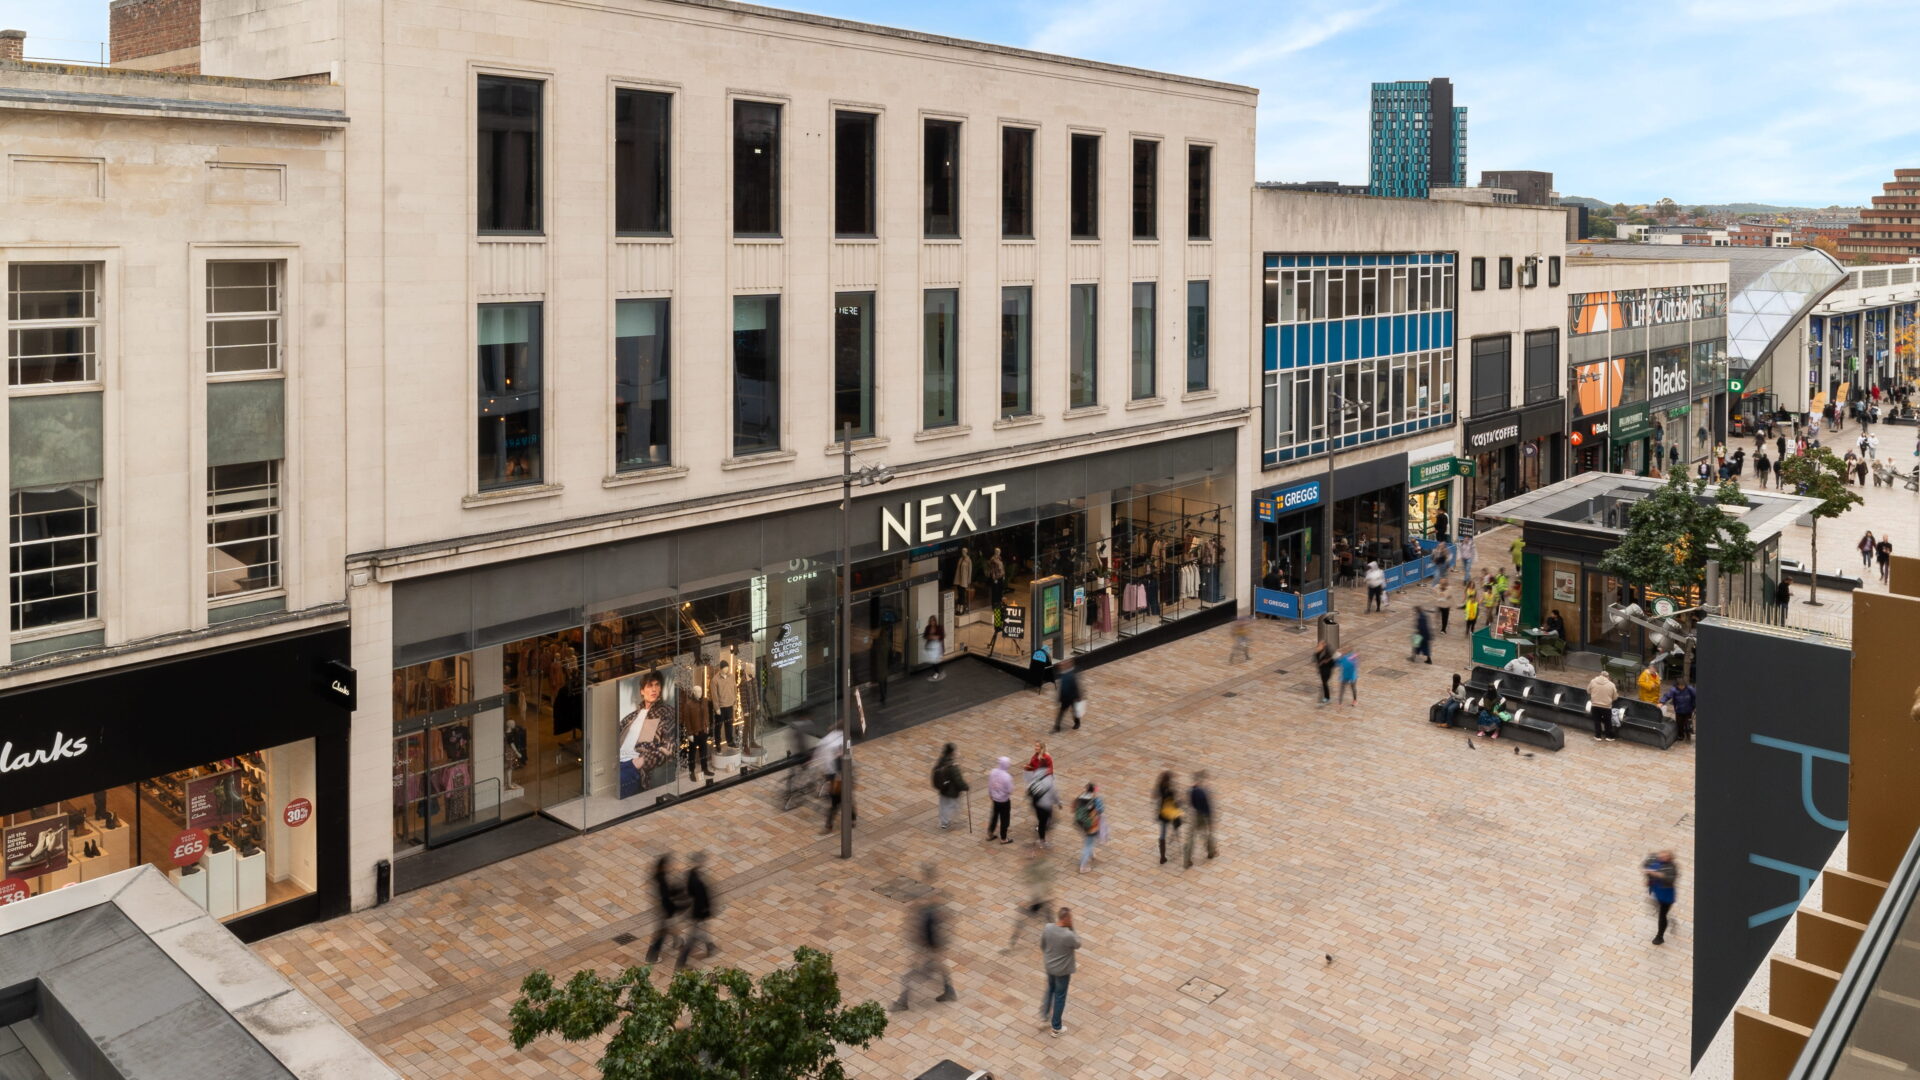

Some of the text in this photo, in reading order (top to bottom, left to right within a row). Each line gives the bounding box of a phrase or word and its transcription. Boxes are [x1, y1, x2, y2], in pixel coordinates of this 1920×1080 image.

[1653, 362, 1687, 398] Blacks
[1731, 381, 1741, 390] D
[1472, 425, 1519, 446] COSTA COFFEE
[1425, 462, 1450, 475] RAMSDENS
[1285, 486, 1318, 507] GREGGS
[882, 483, 1006, 552] NEXT
[787, 571, 818, 583] COFFEE
[1268, 599, 1290, 609] GREGGS
[1006, 608, 1021, 617] TUI
[771, 641, 802, 654] COLECTIONS
[332, 680, 349, 696] Clarks
[8, 842, 33, 852] comfort.
[174, 840, 203, 859] £65
[0, 890, 26, 904] 38
